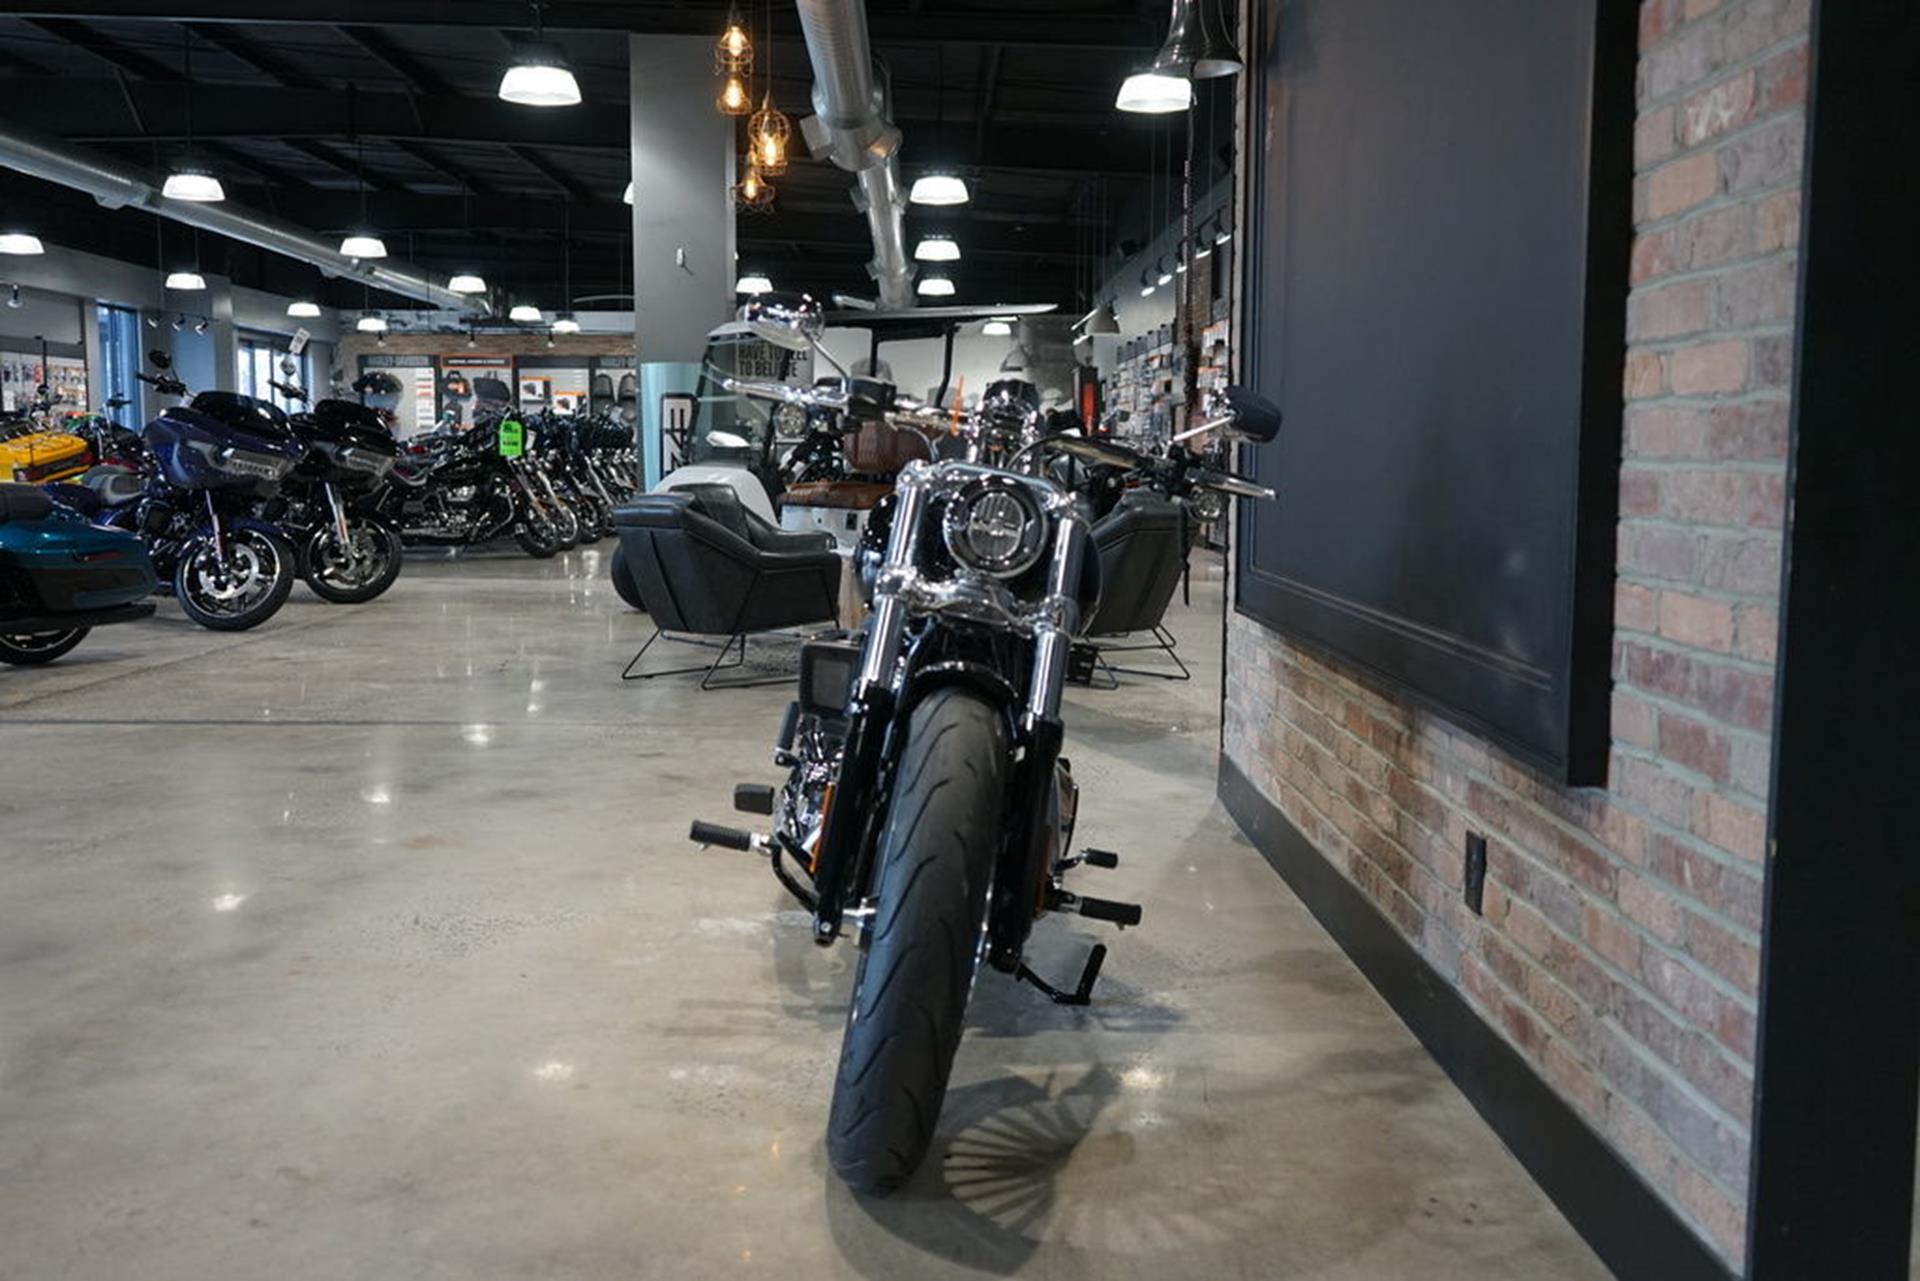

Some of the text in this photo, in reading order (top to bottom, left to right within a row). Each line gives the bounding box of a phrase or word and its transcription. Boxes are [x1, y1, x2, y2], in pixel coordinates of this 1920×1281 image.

[739, 344, 808, 361] HAVE TO EEL
[740, 360, 798, 377] TO BELIE
